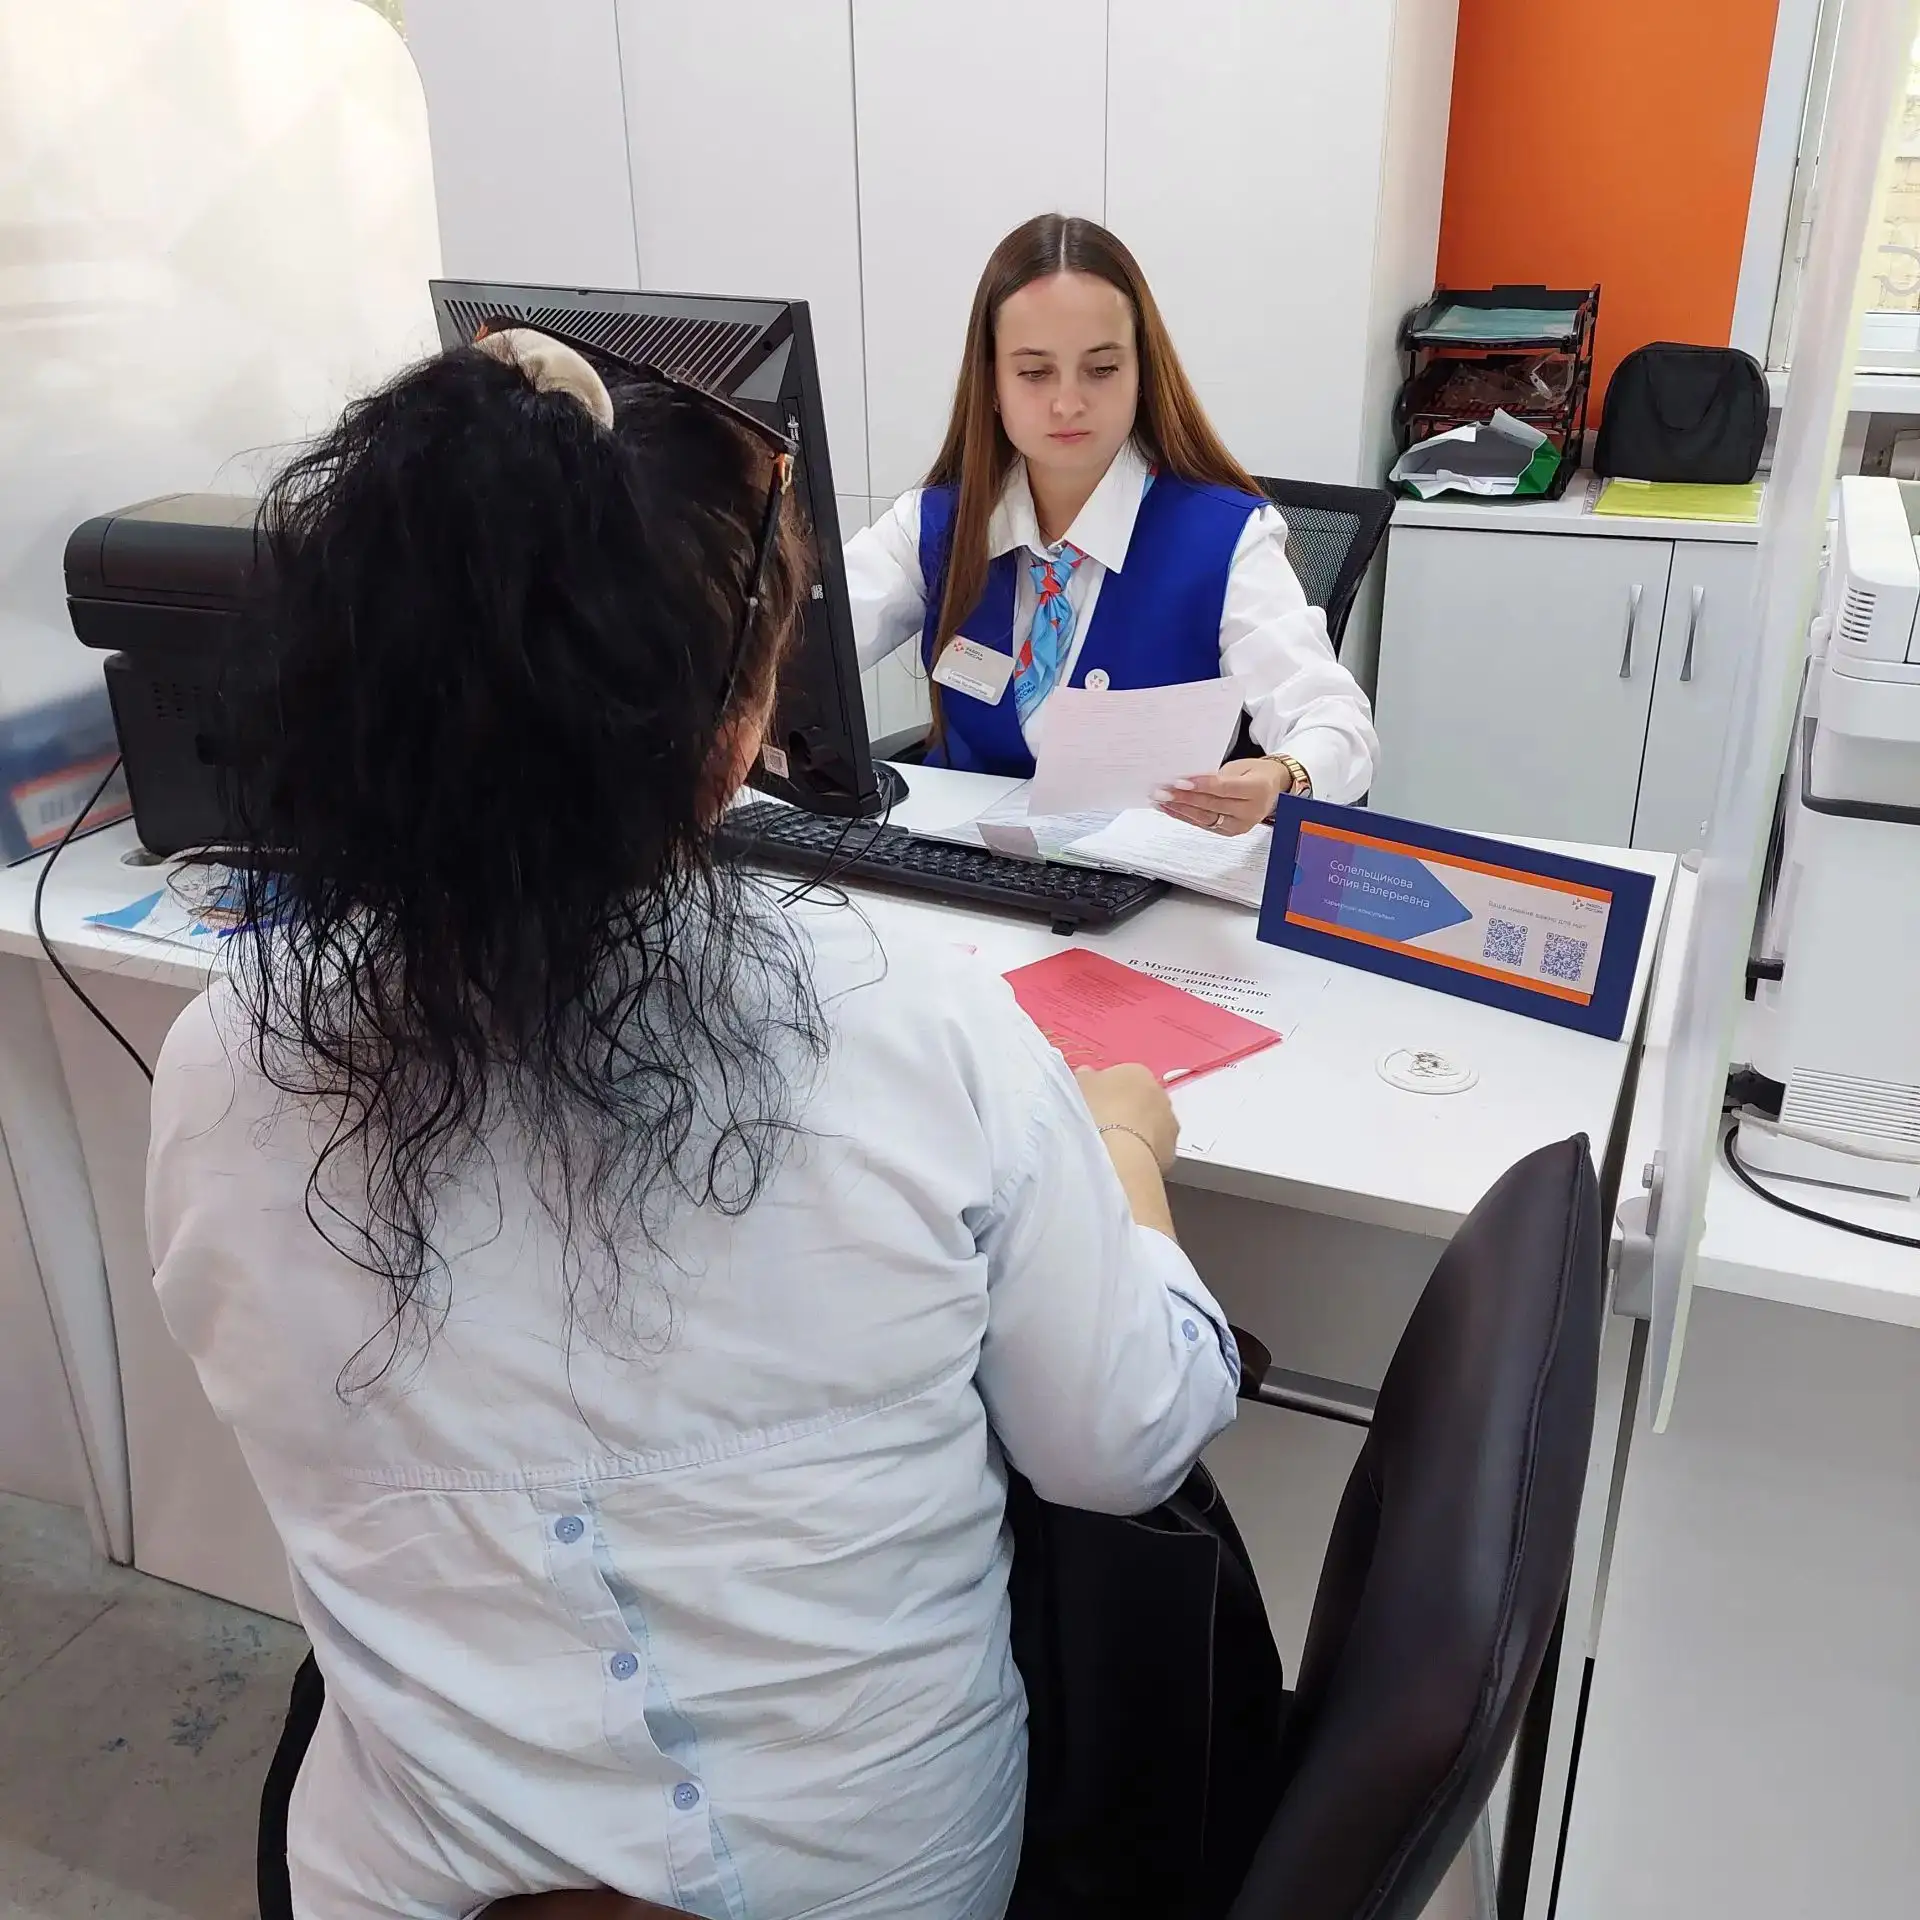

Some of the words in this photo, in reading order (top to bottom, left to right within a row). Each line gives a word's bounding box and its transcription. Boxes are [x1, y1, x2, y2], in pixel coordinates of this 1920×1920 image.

[1329, 859, 1413, 889] Сопельщикова
[1328, 873, 1360, 889] Юлия
[1362, 881, 1430, 908] Валерьевна
